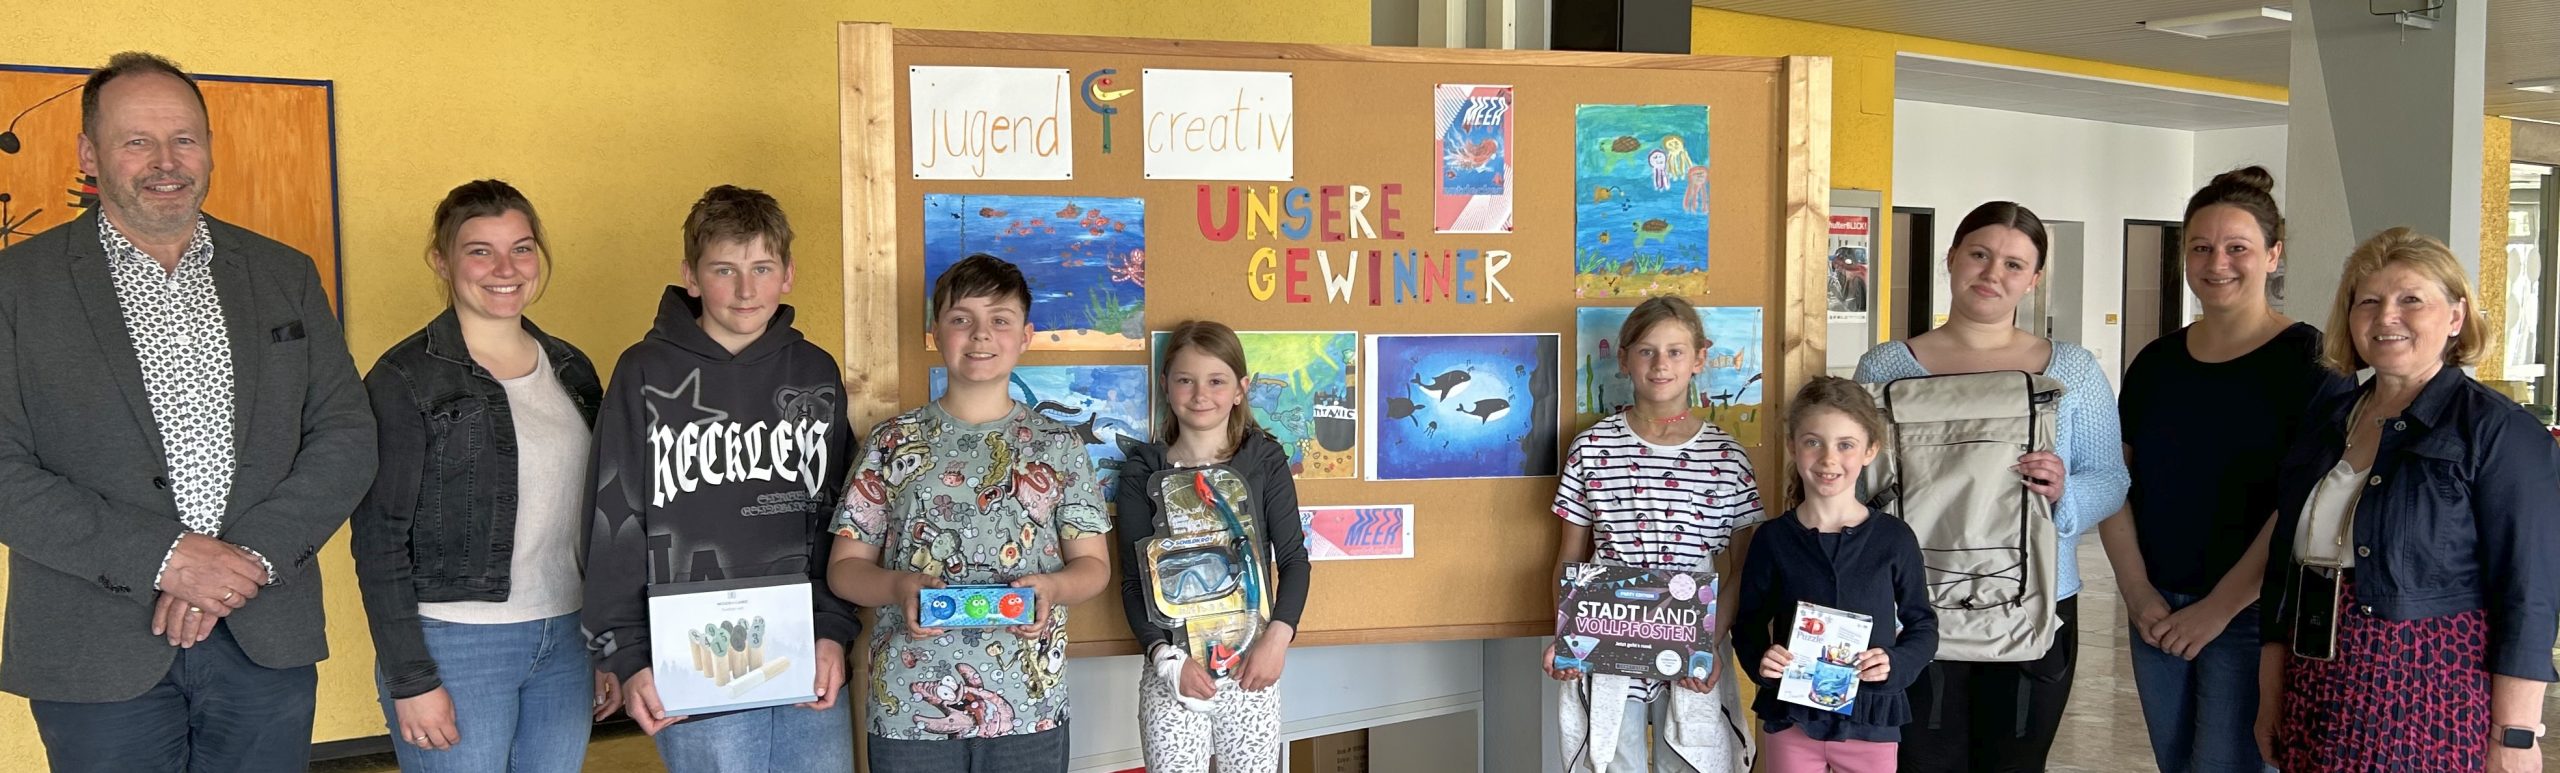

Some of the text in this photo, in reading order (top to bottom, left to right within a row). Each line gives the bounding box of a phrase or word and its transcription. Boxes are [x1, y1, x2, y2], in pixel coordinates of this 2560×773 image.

[1463, 96, 1509, 126] MEER
[921, 74, 1292, 178] jugend creativ
[1197, 183, 1405, 242] UNSERE
[1248, 247, 1514, 307] GEWINNER
[1314, 408, 1355, 419] TITANIC
[1576, 600, 1697, 626] STADT LAND
[1575, 616, 1697, 642] VOLLPFOSTEN
[1796, 631, 1824, 644] Puzzle
